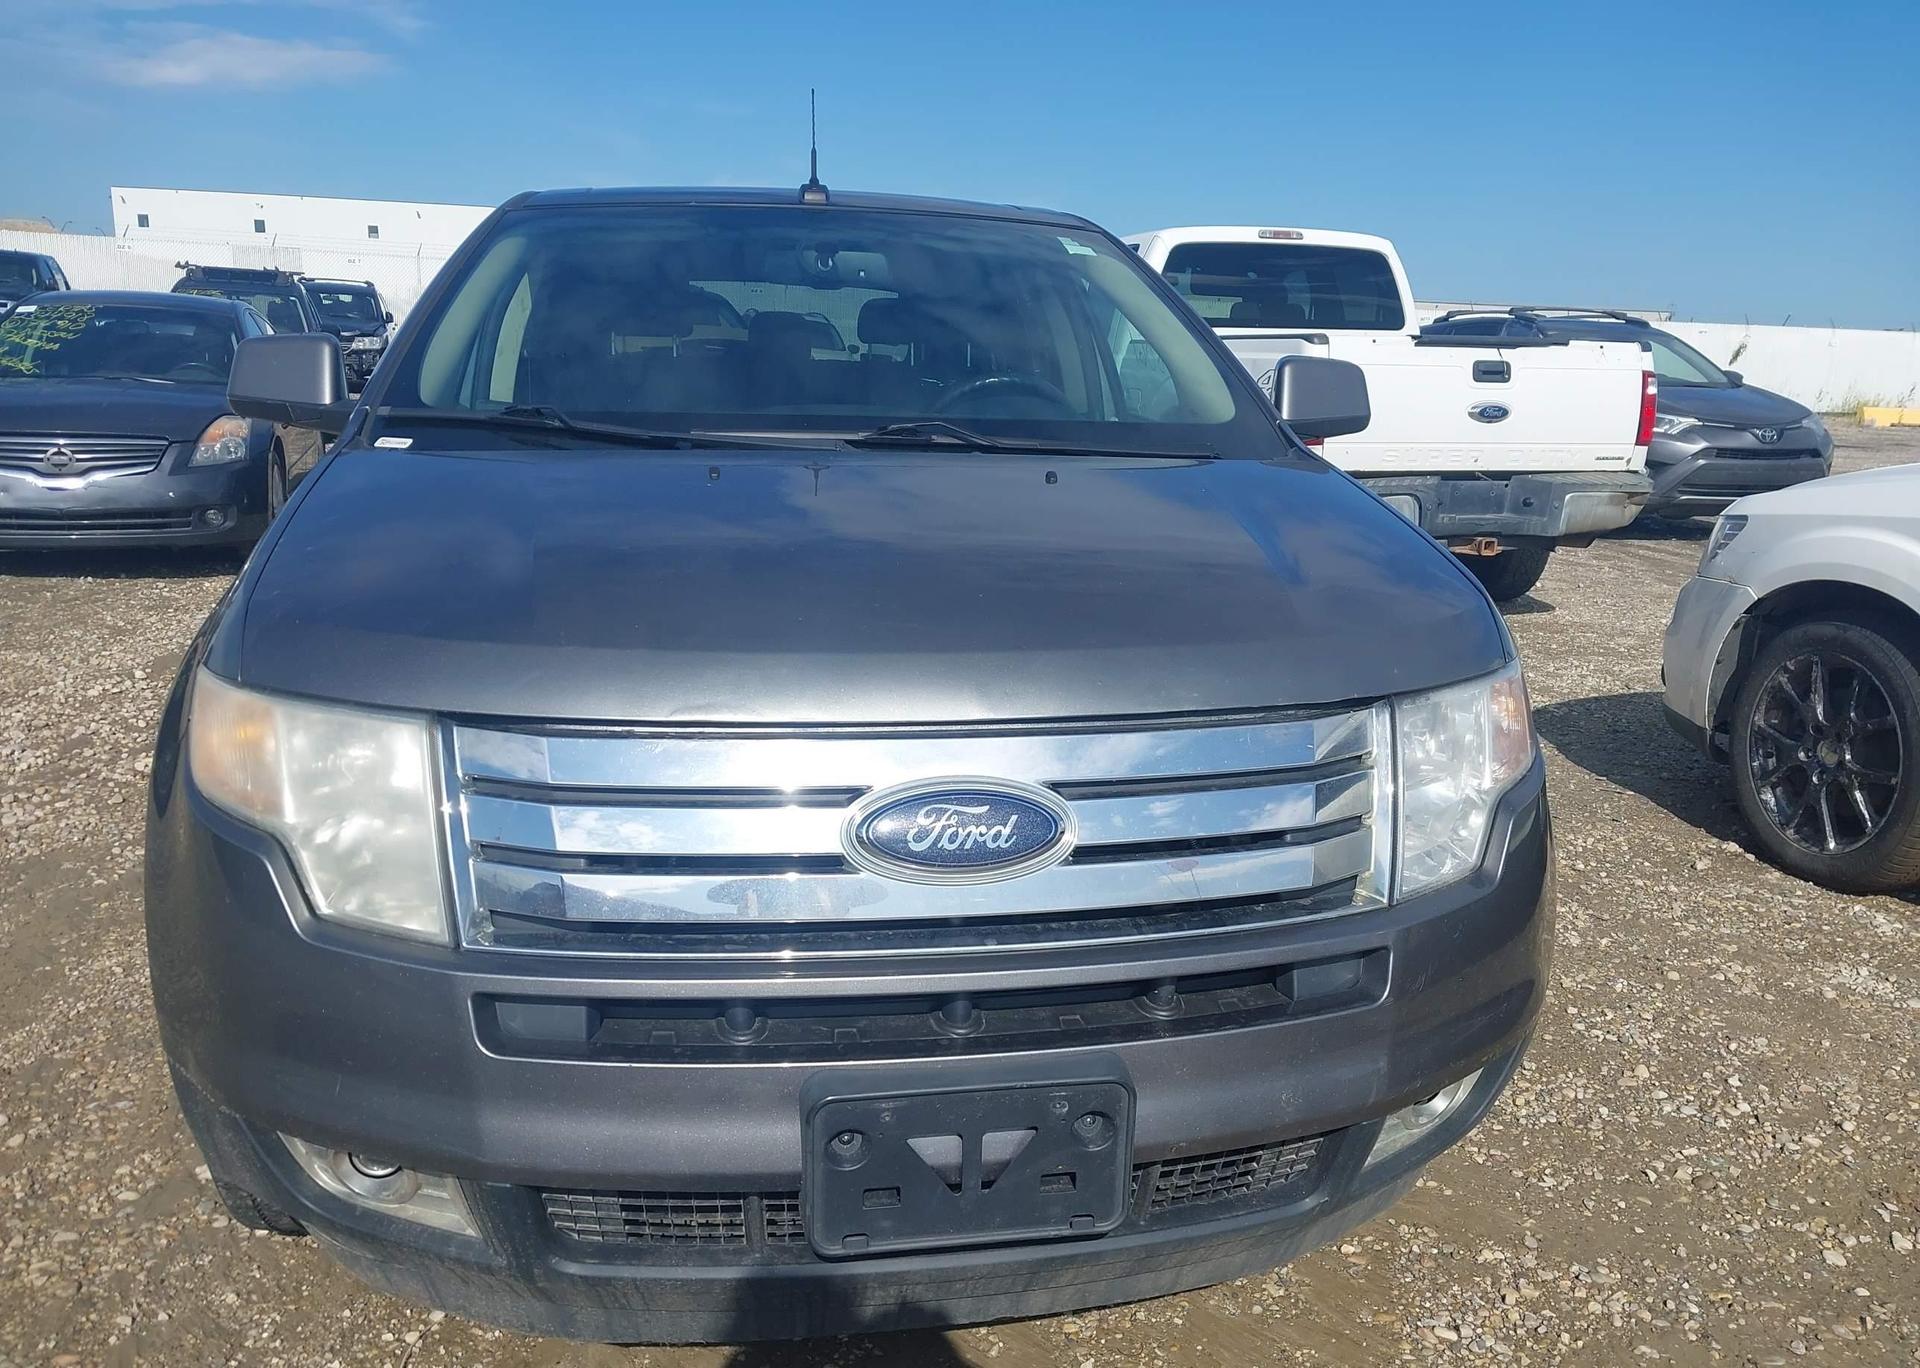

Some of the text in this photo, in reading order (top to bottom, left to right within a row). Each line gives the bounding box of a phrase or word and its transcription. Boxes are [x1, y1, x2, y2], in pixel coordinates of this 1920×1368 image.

[1381, 448, 1583, 466] SUPER DUTY
[906, 803, 1018, 852] Ford
